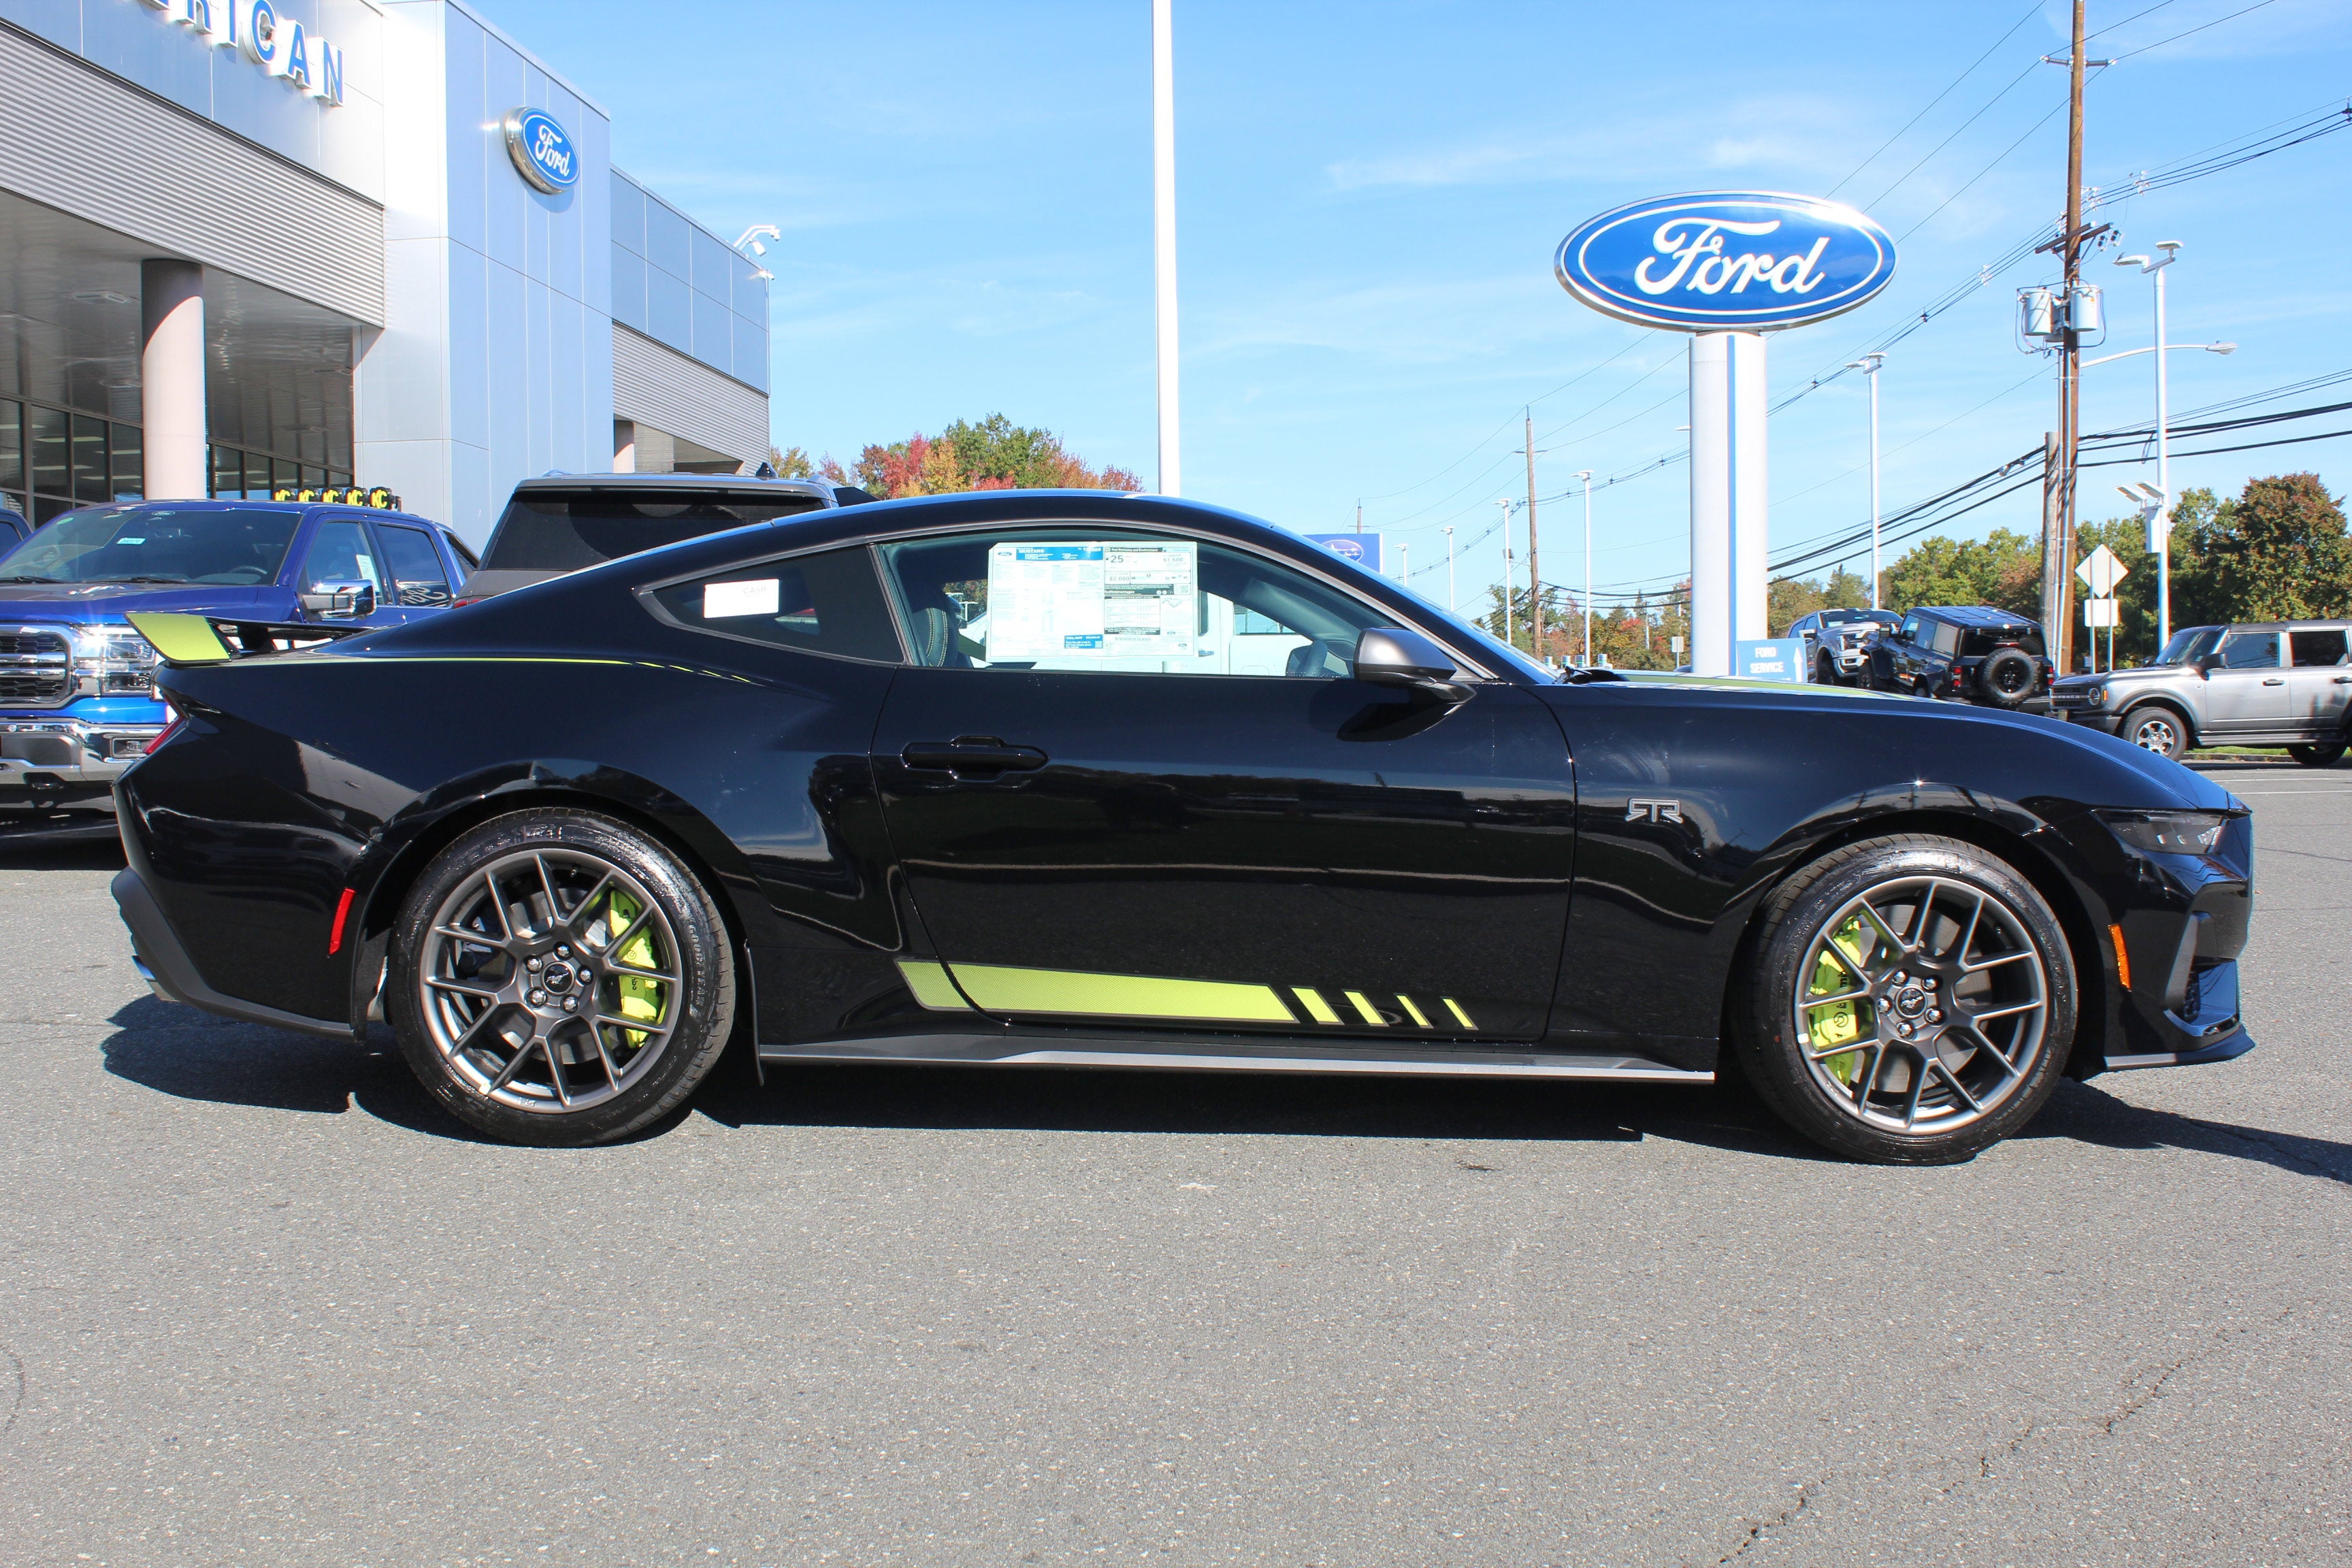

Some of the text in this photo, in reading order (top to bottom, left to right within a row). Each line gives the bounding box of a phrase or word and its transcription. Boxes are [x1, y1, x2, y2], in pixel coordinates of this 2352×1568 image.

[535, 125, 570, 177] Ford
[1634, 217, 1830, 295] Ford
[323, 489, 339, 504] KC
[347, 489, 363, 506] KC
[372, 489, 387, 509] KC
[1111, 555, 1124, 564] 25
[1754, 647, 1777, 658] FORD
[1750, 662, 1784, 674] SERVICE
